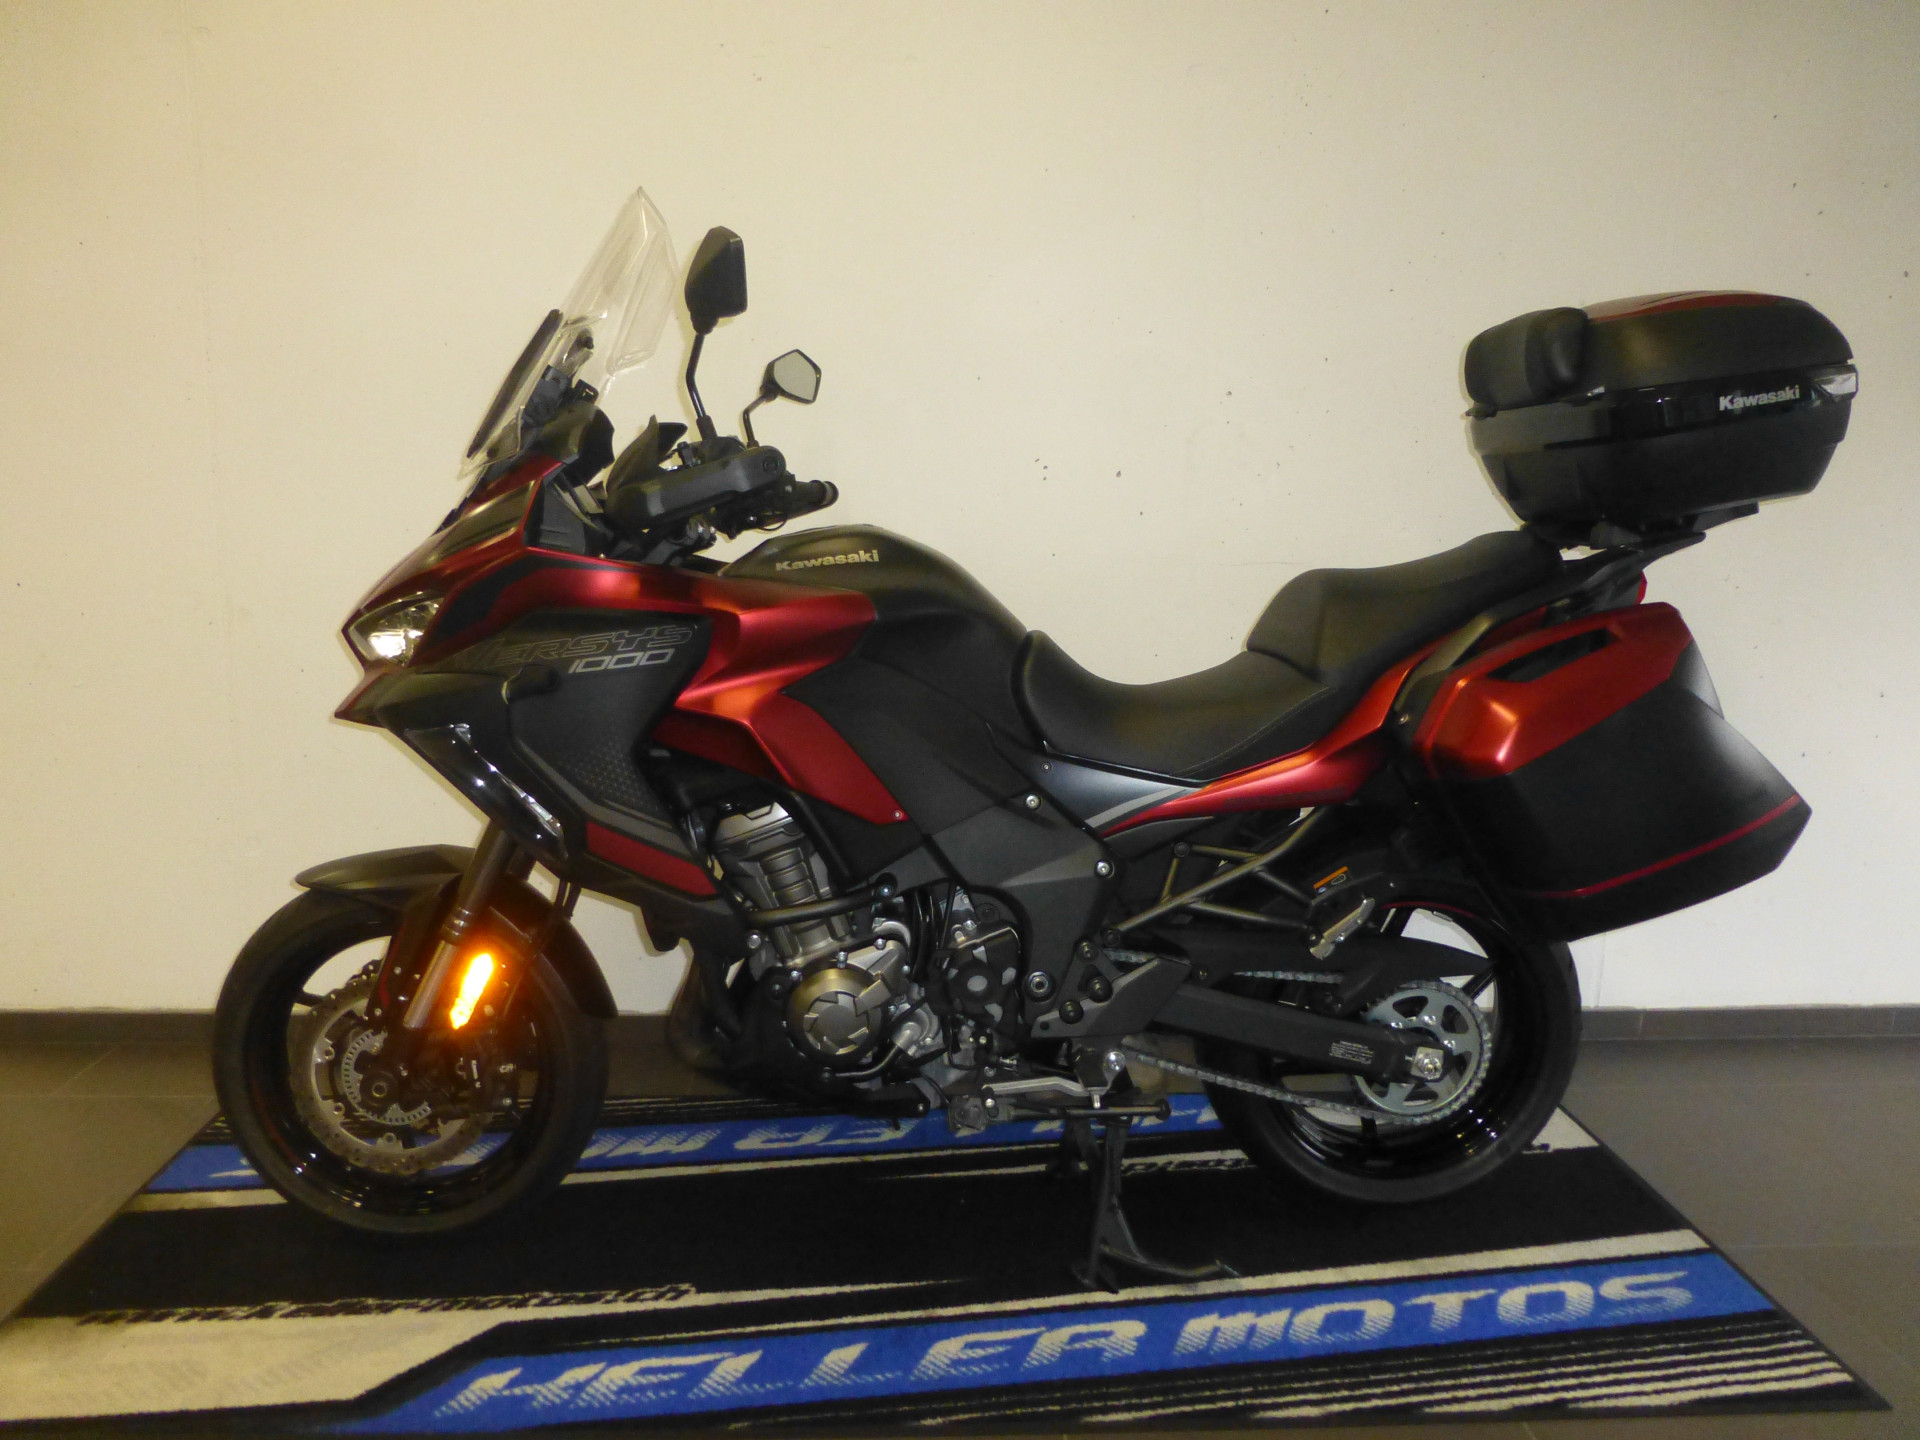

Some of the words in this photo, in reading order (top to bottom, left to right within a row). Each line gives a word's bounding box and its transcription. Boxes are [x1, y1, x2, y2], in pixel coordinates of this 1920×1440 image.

[1719, 385, 1800, 411] Kawasaki
[775, 549, 880, 571] Kawasaki
[568, 648, 675, 674] 1000
[1172, 1270, 1693, 1357] MOTOS
